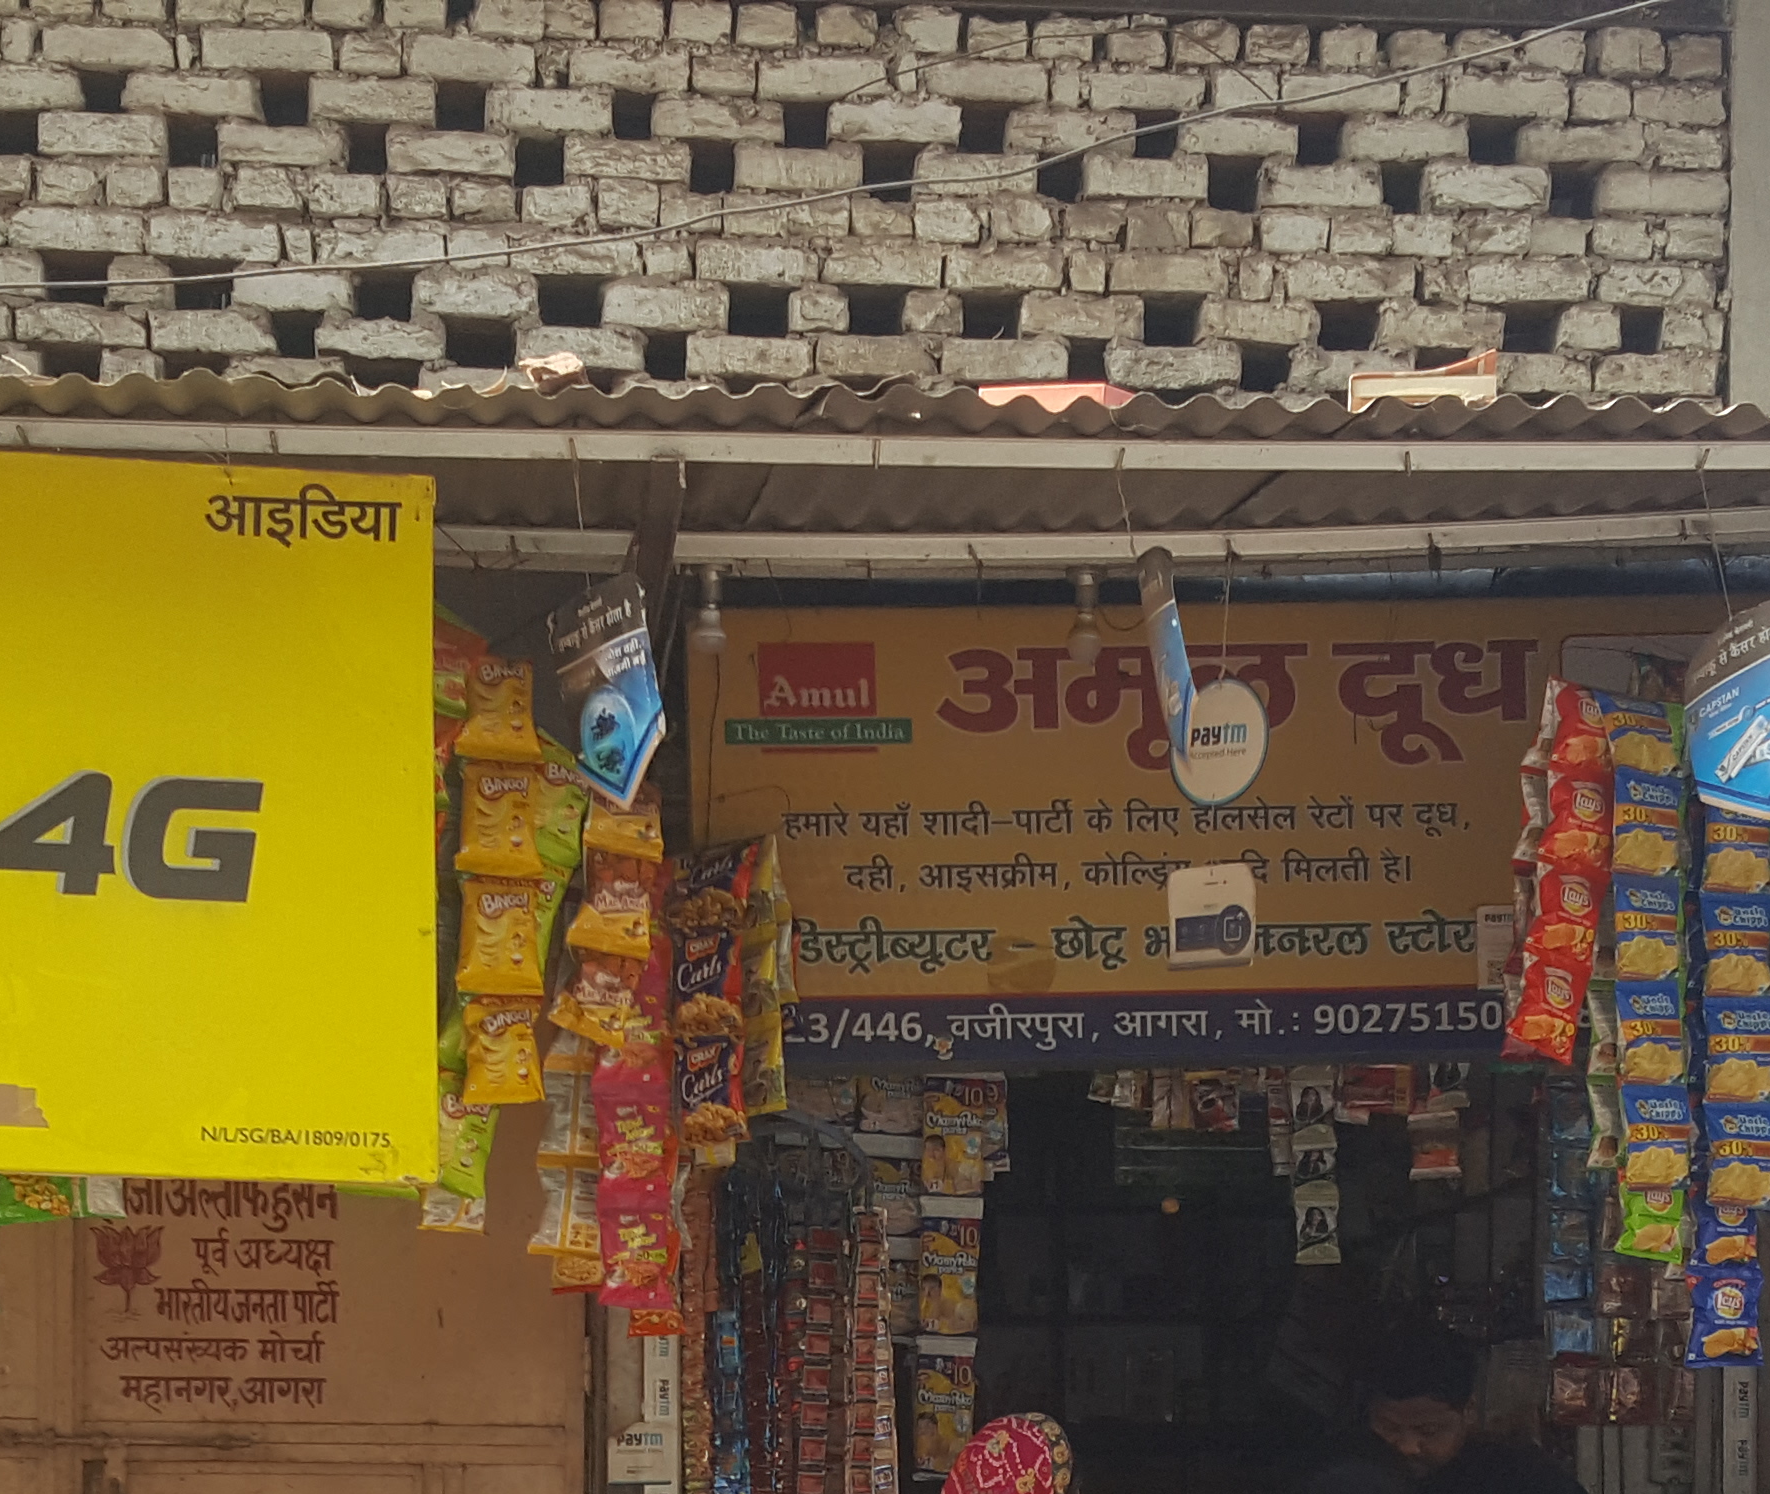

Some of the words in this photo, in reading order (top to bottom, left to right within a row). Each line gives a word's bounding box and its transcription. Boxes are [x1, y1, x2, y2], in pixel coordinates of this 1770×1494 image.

[204, 489, 400, 551] आइडिया
[763, 675, 871, 710] Amul
[1332, 638, 1538, 765] दूध
[733, 722, 770, 741] The
[778, 721, 825, 741] Taste
[830, 721, 850, 741] of
[855, 721, 905, 741] India
[782, 801, 849, 840] हमारे
[858, 800, 912, 837] यहाँ
[1084, 800, 1114, 833] के
[1123, 800, 1179, 837] लिए
[1365, 802, 1403, 830] पर
[1413, 800, 1471, 838] दूध,
[842, 854, 908, 893] दही,
[1283, 846, 1371, 884] मिलती
[1052, 915, 1129, 971] छोटू
[1385, 908, 1478, 958] स्टोर
[1113, 1009, 1224, 1042] आगरा,
[1313, 1002, 1503, 1036] 90275150
[200, 1126, 391, 1149] N/L/SG/BA/1809/0175
[234, 1238, 334, 1277] अध्यक्ष
[155, 1279, 229, 1325] भारतीय
[231, 1289, 287, 1324] जनता
[293, 1278, 339, 1324] पार्टी
[258, 1331, 325, 1363] मोर्चा
